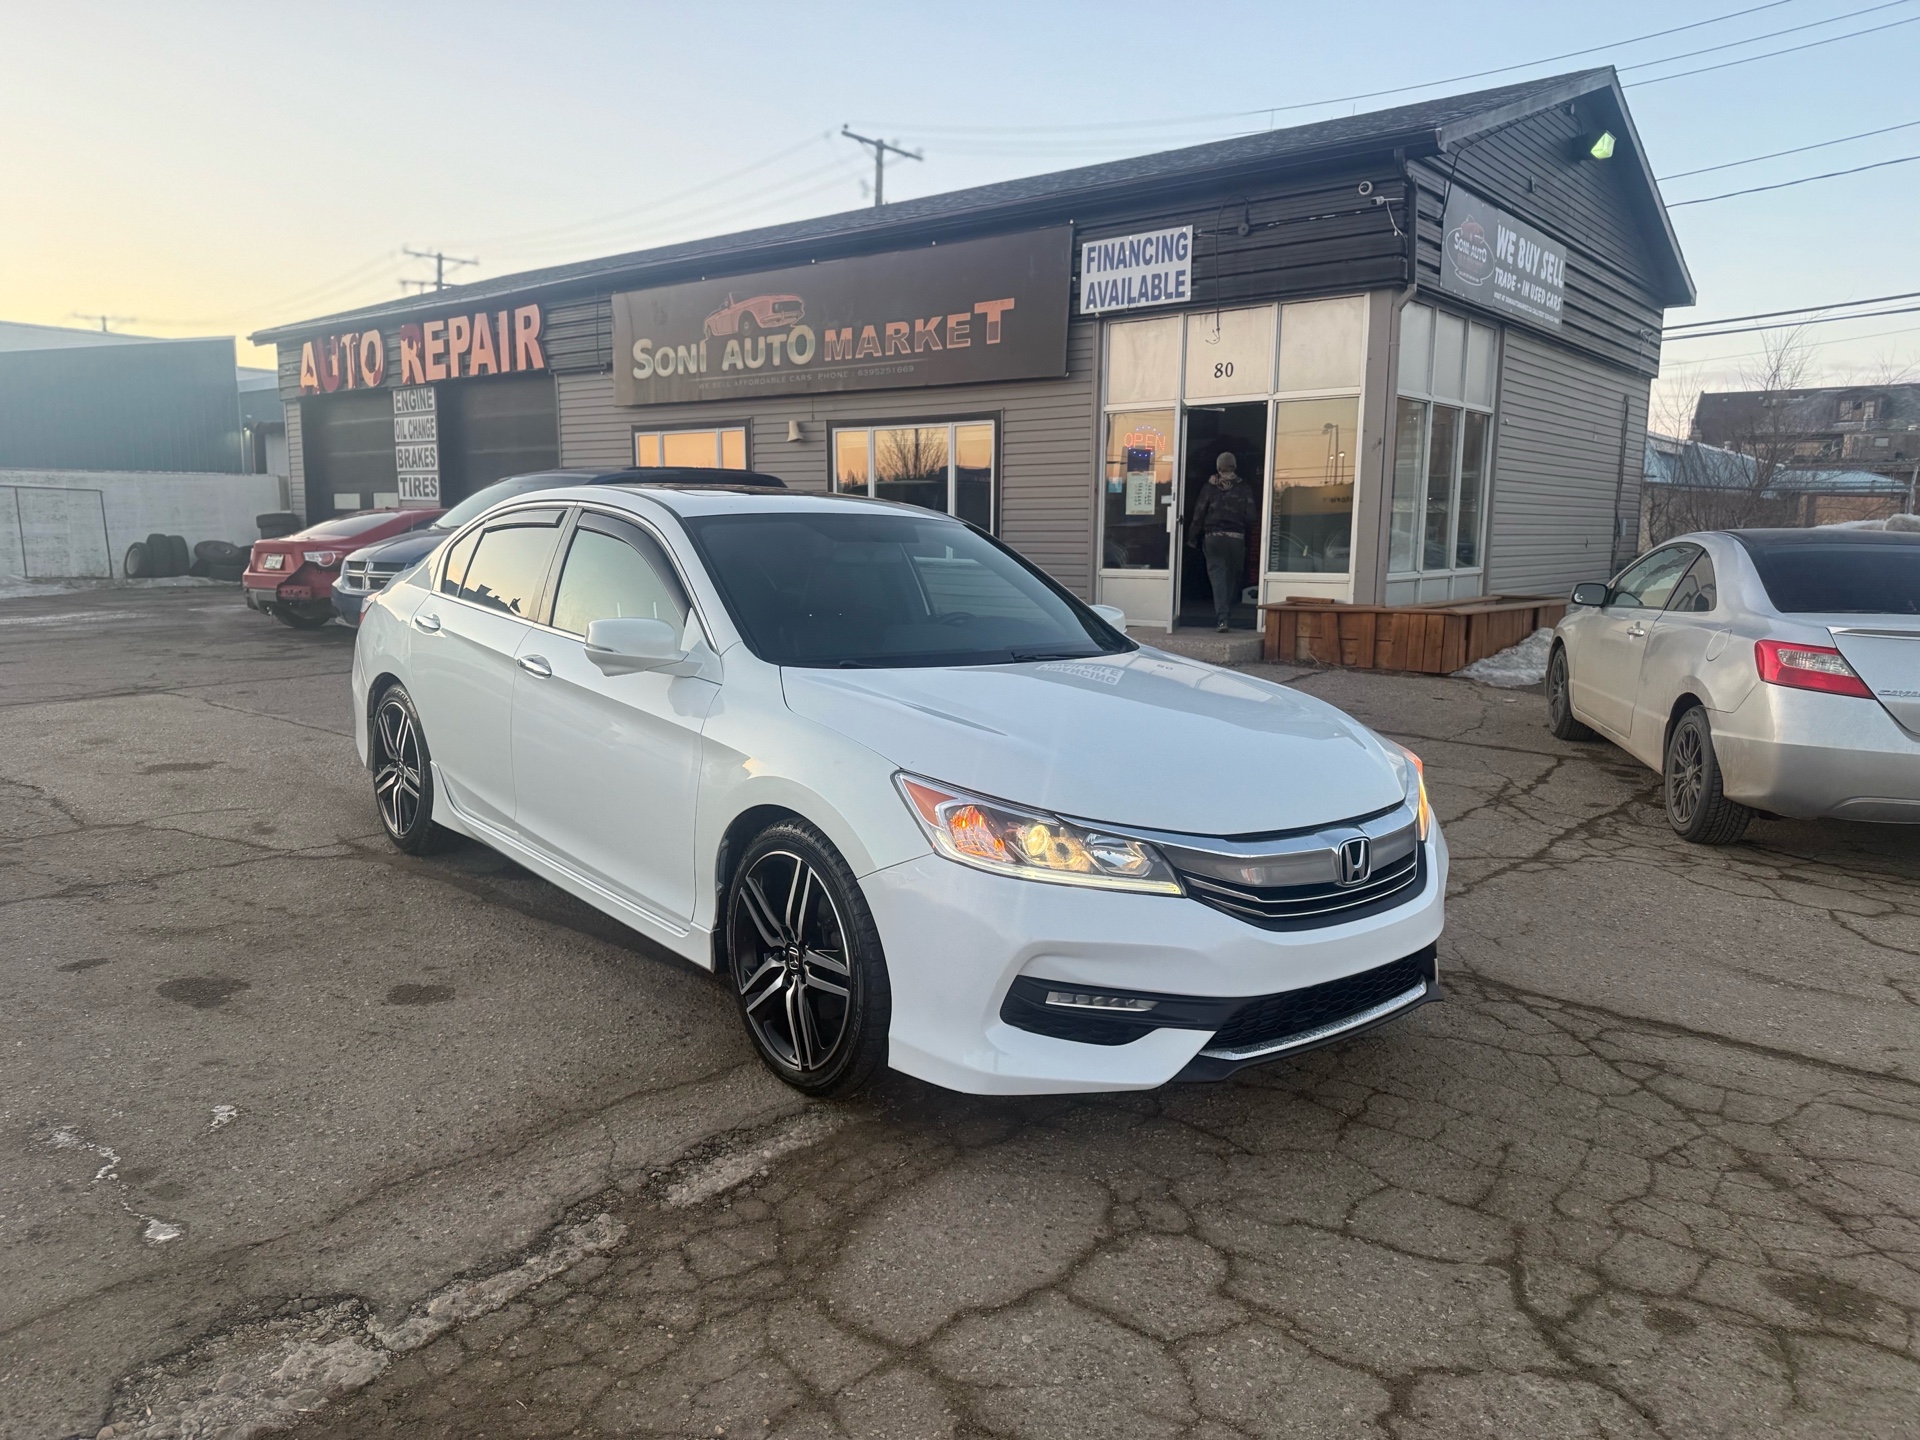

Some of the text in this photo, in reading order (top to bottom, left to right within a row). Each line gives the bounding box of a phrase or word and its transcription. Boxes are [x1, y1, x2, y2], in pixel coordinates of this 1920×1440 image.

[1086, 232, 1189, 275] FINANCING
[1470, 244, 1487, 263] AUTO
[1496, 224, 1565, 289] WE BUY SELL
[1085, 269, 1187, 310] AVAILABLE
[1494, 266, 1517, 292] TRADE
[1521, 279, 1530, 297] IN
[1530, 284, 1546, 305] USED
[1546, 291, 1562, 312] CARS
[299, 303, 546, 396] AUTO REPAIR
[632, 298, 1016, 380] SONI AUTO MARKET
[734, 375, 787, 387] AFFORDABLE
[789, 374, 813, 383] CARS
[817, 371, 849, 380] PHONE
[1213, 361, 1234, 379] 80
[394, 387, 434, 412] ENGINE
[395, 417, 435, 440] OIL CHANGE
[1123, 432, 1167, 452] OPEN
[397, 446, 437, 469] BRAKES
[399, 477, 438, 498] TIRES
